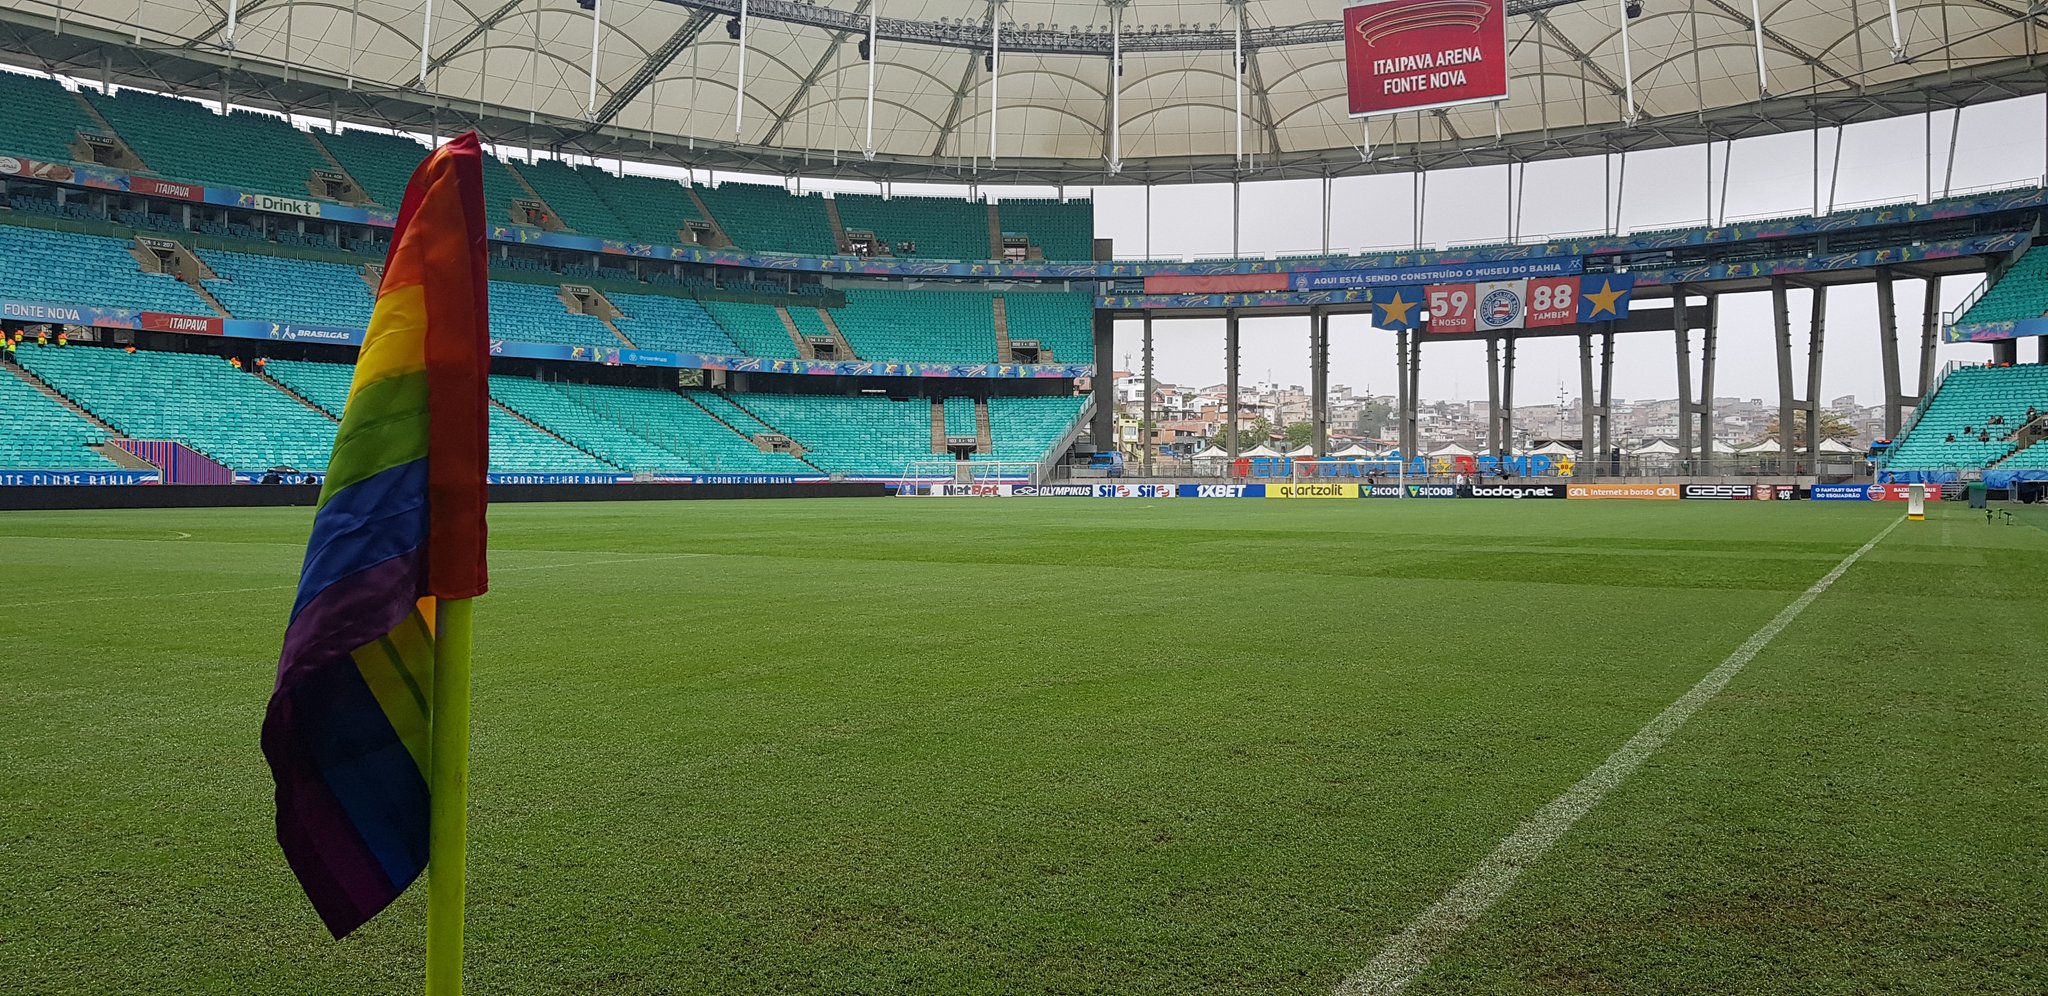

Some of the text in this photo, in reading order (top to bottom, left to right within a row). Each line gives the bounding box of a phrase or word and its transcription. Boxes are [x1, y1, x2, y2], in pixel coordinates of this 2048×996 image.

[1373, 46, 1482, 75] ITAIPAVA ARENA
[1384, 70, 1467, 95] FONTE NOVA
[155, 183, 190, 198] ITAIPAVA
[263, 197, 301, 213] Drink
[1314, 277, 1337, 285] AQUI
[1340, 275, 1363, 283] ESTÁ
[1365, 274, 1398, 282] SENDO
[1400, 269, 1463, 280] CONSTRUÍDO
[1475, 267, 1510, 276] MUSEU
[1529, 263, 1561, 272] BAHIA
[1430, 290, 1468, 317] 59
[1533, 284, 1573, 311] 88
[4, 304, 80, 321] FONTE NOVA
[1533, 310, 1570, 321] TAMBEM
[169, 317, 208, 332] ITAIPAVA
[1431, 318, 1467, 327] É NOSSO
[943, 485, 999, 496] NetBet
[1040, 486, 1091, 496] OLYMPIKUS
[1099, 485, 1155, 497] Sil Sil
[1197, 484, 1246, 497] 1XBET
[1280, 485, 1343, 497] quartzolit
[1419, 487, 1453, 496] SICOOB
[1472, 486, 1553, 498] bodog.net
[1569, 488, 1588, 496] GOL
[1656, 488, 1678, 496] GOL
